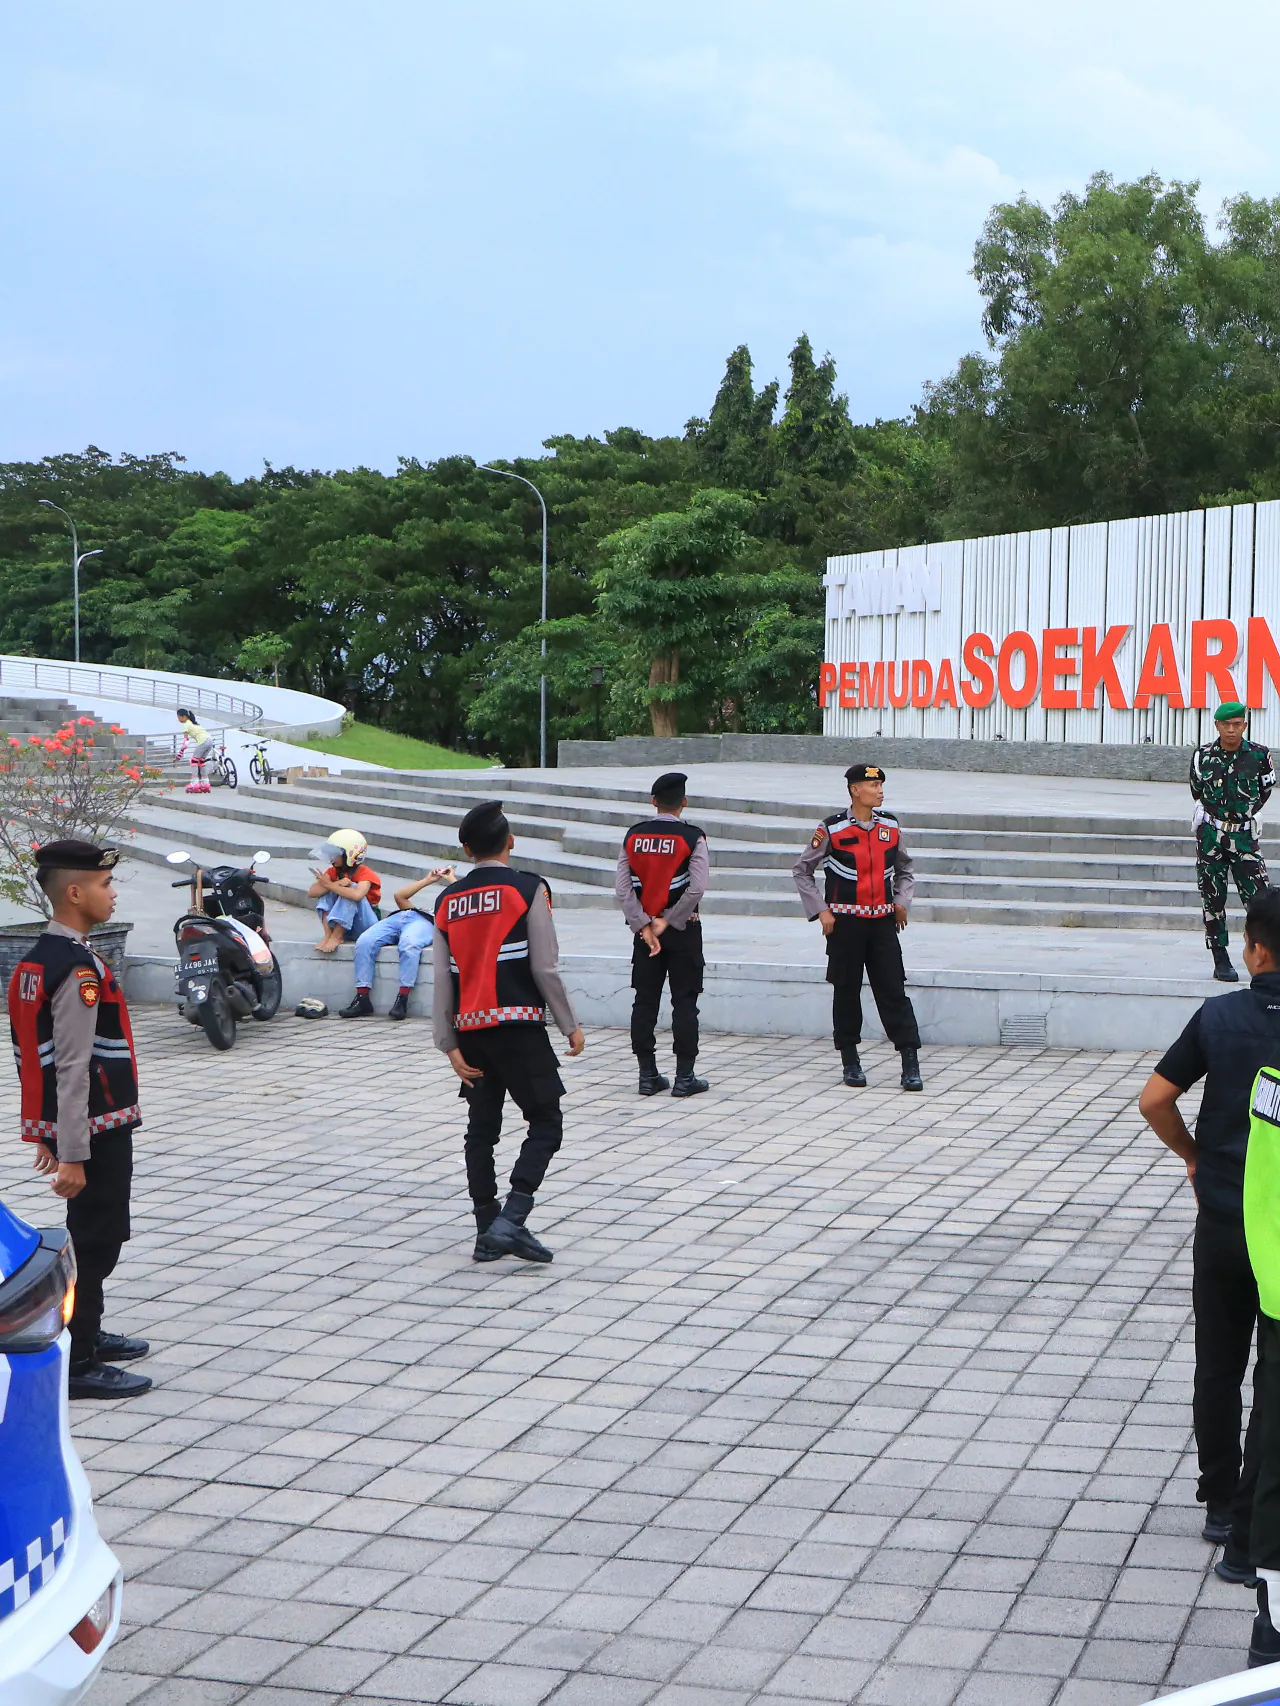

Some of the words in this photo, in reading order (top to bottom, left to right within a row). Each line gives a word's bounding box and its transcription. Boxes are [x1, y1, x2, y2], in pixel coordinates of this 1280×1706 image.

[822, 561, 942, 620] TAMAN
[819, 659, 958, 708] PEMUDA
[634, 838, 675, 854] POLISI
[448, 890, 501, 920] POLISI
